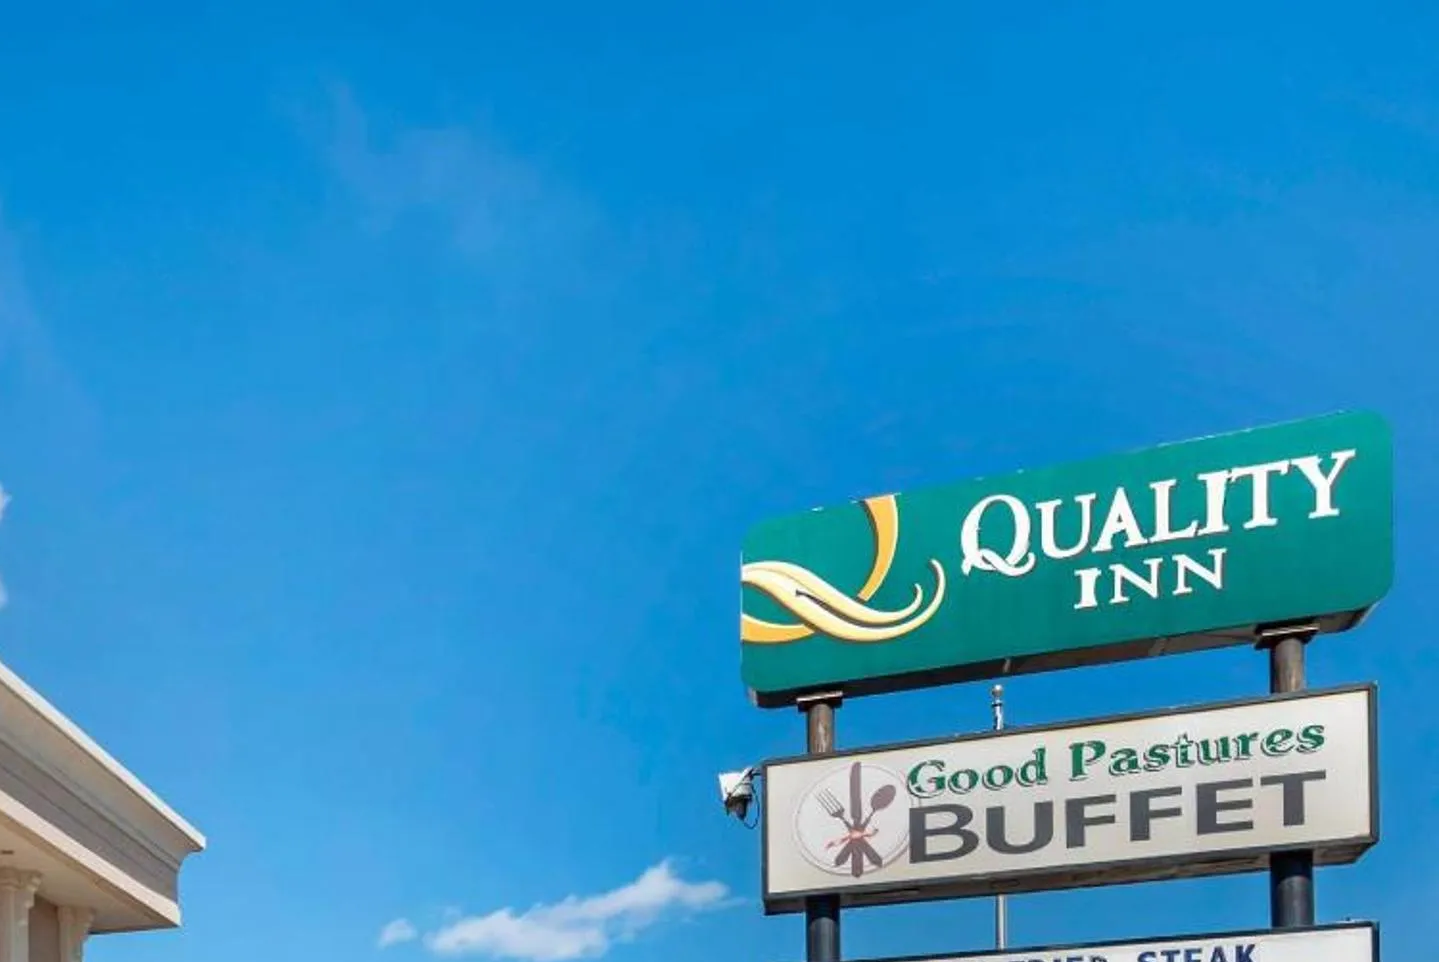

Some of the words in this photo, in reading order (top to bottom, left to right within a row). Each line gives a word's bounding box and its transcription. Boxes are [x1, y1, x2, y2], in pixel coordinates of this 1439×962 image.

[960, 449, 1356, 577] QUALITY
[1073, 548, 1227, 609] INN
[907, 747, 1048, 798] Good
[1068, 723, 1326, 781] Pastures
[908, 770, 1326, 864] BUFFET
